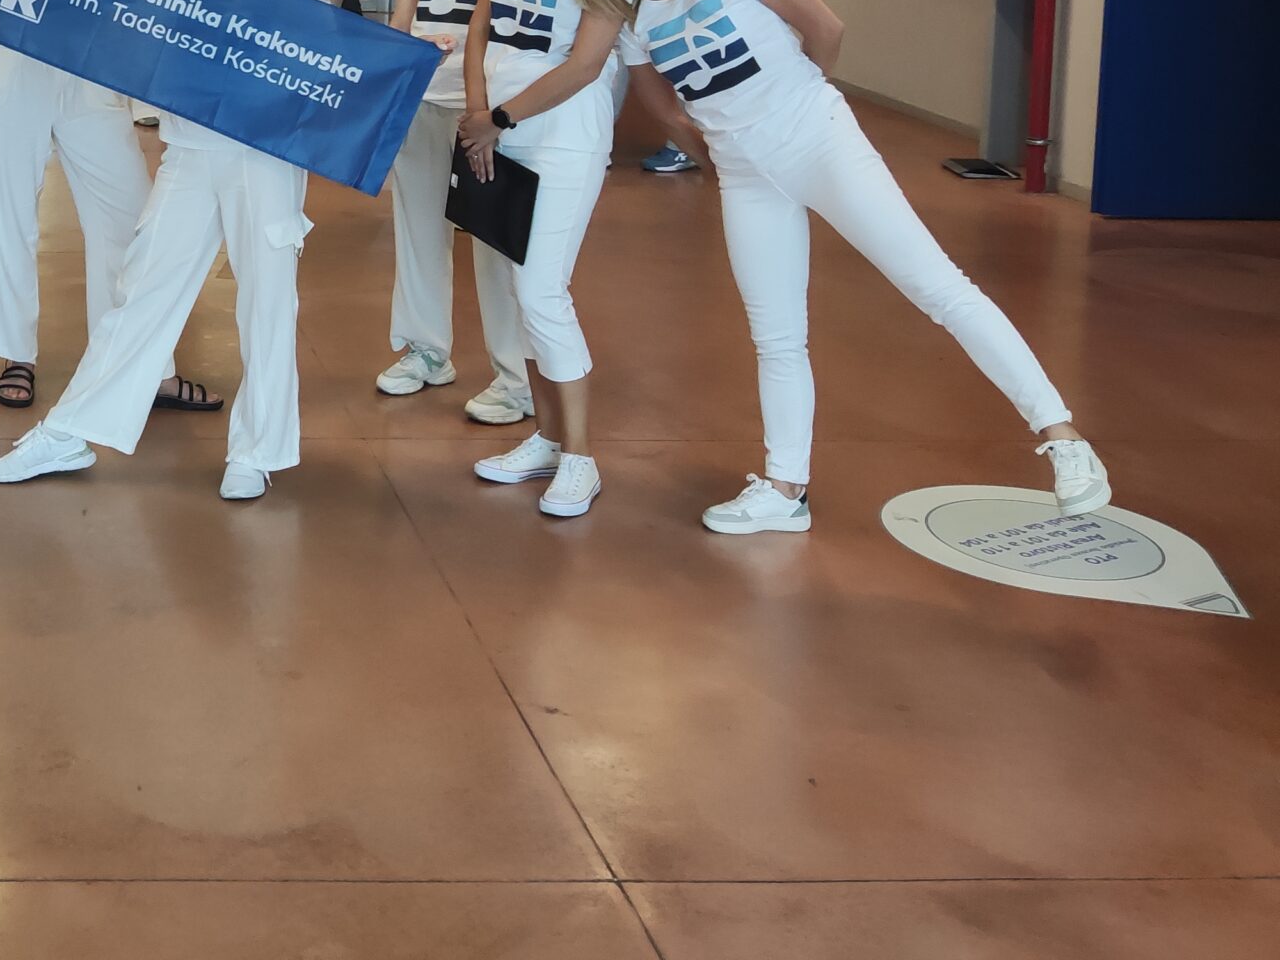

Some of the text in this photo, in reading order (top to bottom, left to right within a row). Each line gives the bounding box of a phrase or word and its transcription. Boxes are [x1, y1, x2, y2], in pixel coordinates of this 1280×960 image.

[226, 14, 364, 84] Krakowska
[111, 2, 219, 60] Tadeusza
[222, 46, 345, 109] Kościuszki
[1024, 522, 1045, 531] da
[1065, 521, 1102, 533] Aule
[998, 528, 1028, 538] 101
[1046, 529, 1067, 538] da
[958, 537, 989, 548] 104
[1019, 533, 1106, 558] Area Ristoro
[1021, 535, 1051, 545] 101
[981, 544, 1011, 555] 110
[1084, 552, 1119, 565] PTO
